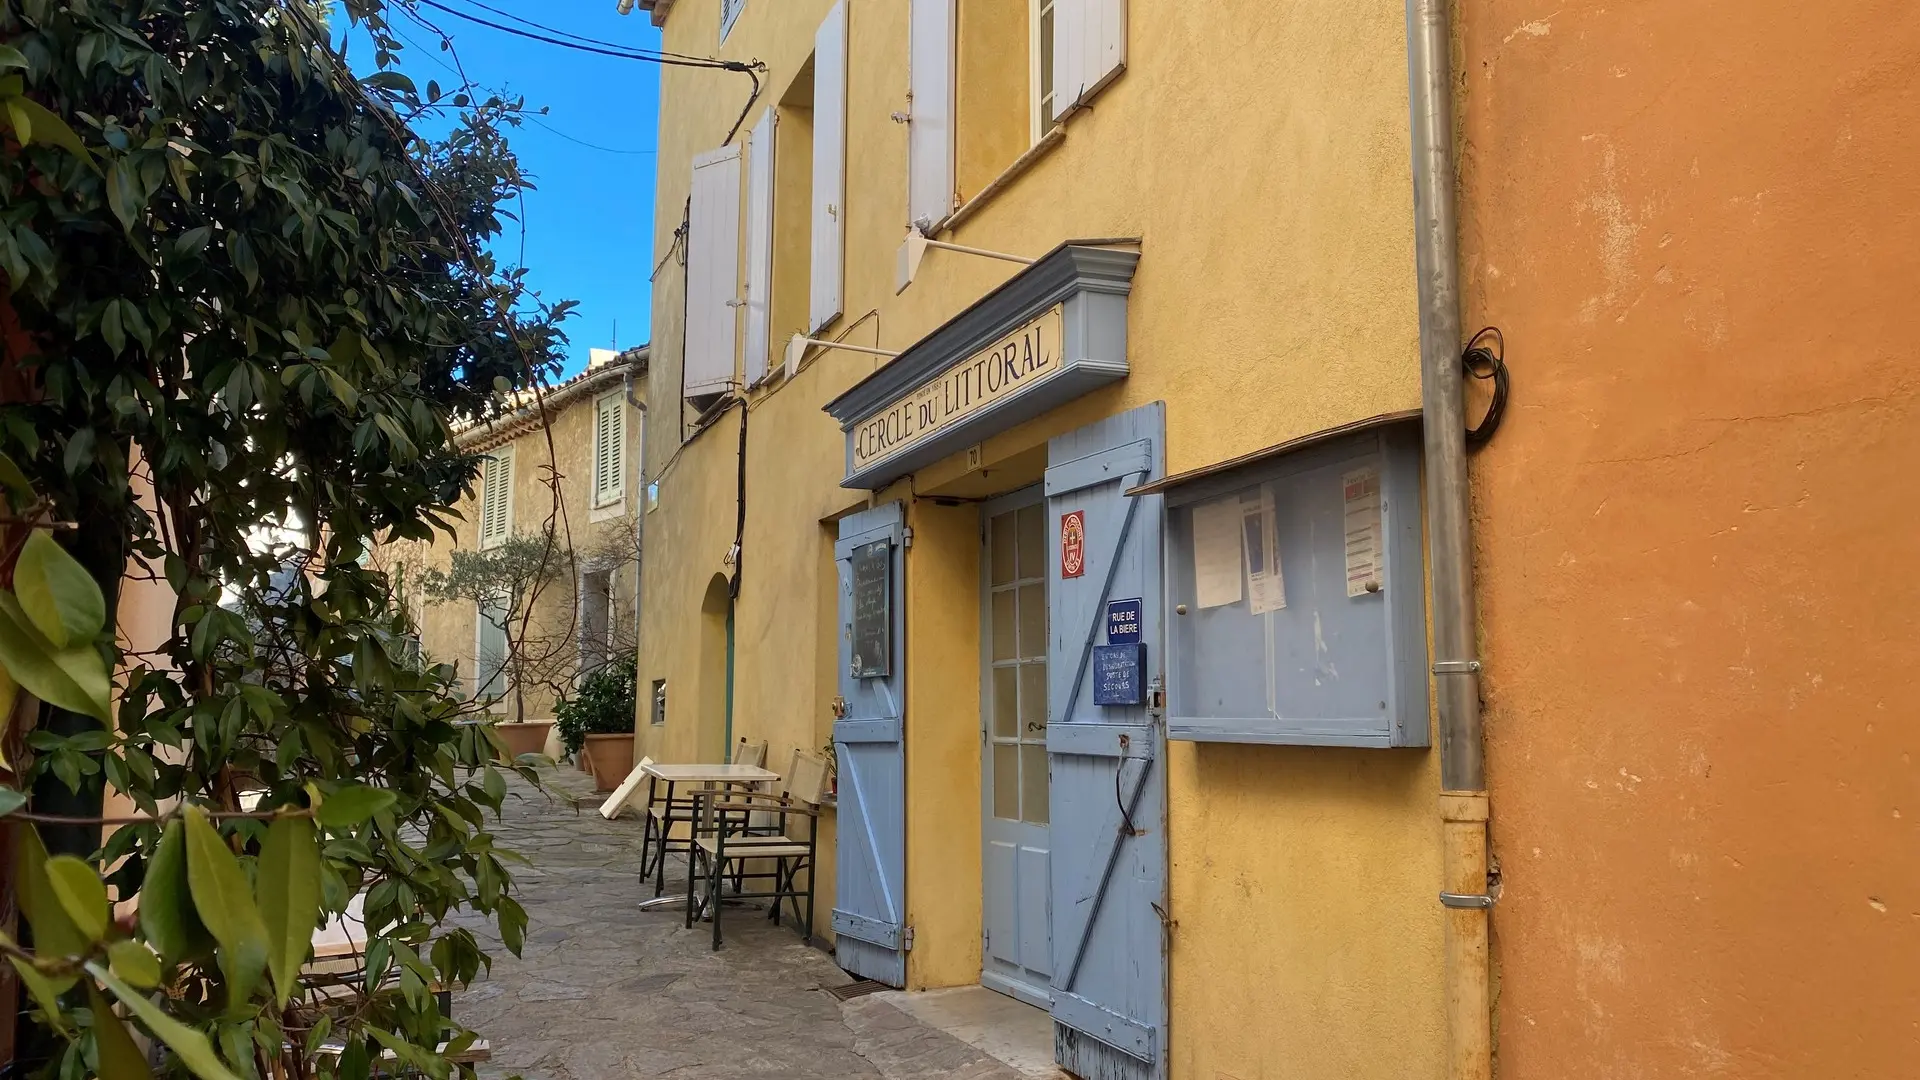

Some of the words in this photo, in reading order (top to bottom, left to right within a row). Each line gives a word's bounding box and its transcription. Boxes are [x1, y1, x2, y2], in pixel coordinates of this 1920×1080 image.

[858, 401, 914, 460] CERCLE
[919, 395, 938, 430] DU
[944, 326, 1051, 417] LITTORAL
[970, 449, 977, 466] 70
[1112, 611, 1125, 622] RUE
[1126, 610, 1135, 621] DE
[1110, 625, 1119, 635] LA
[1119, 623, 1138, 634] BIERE
